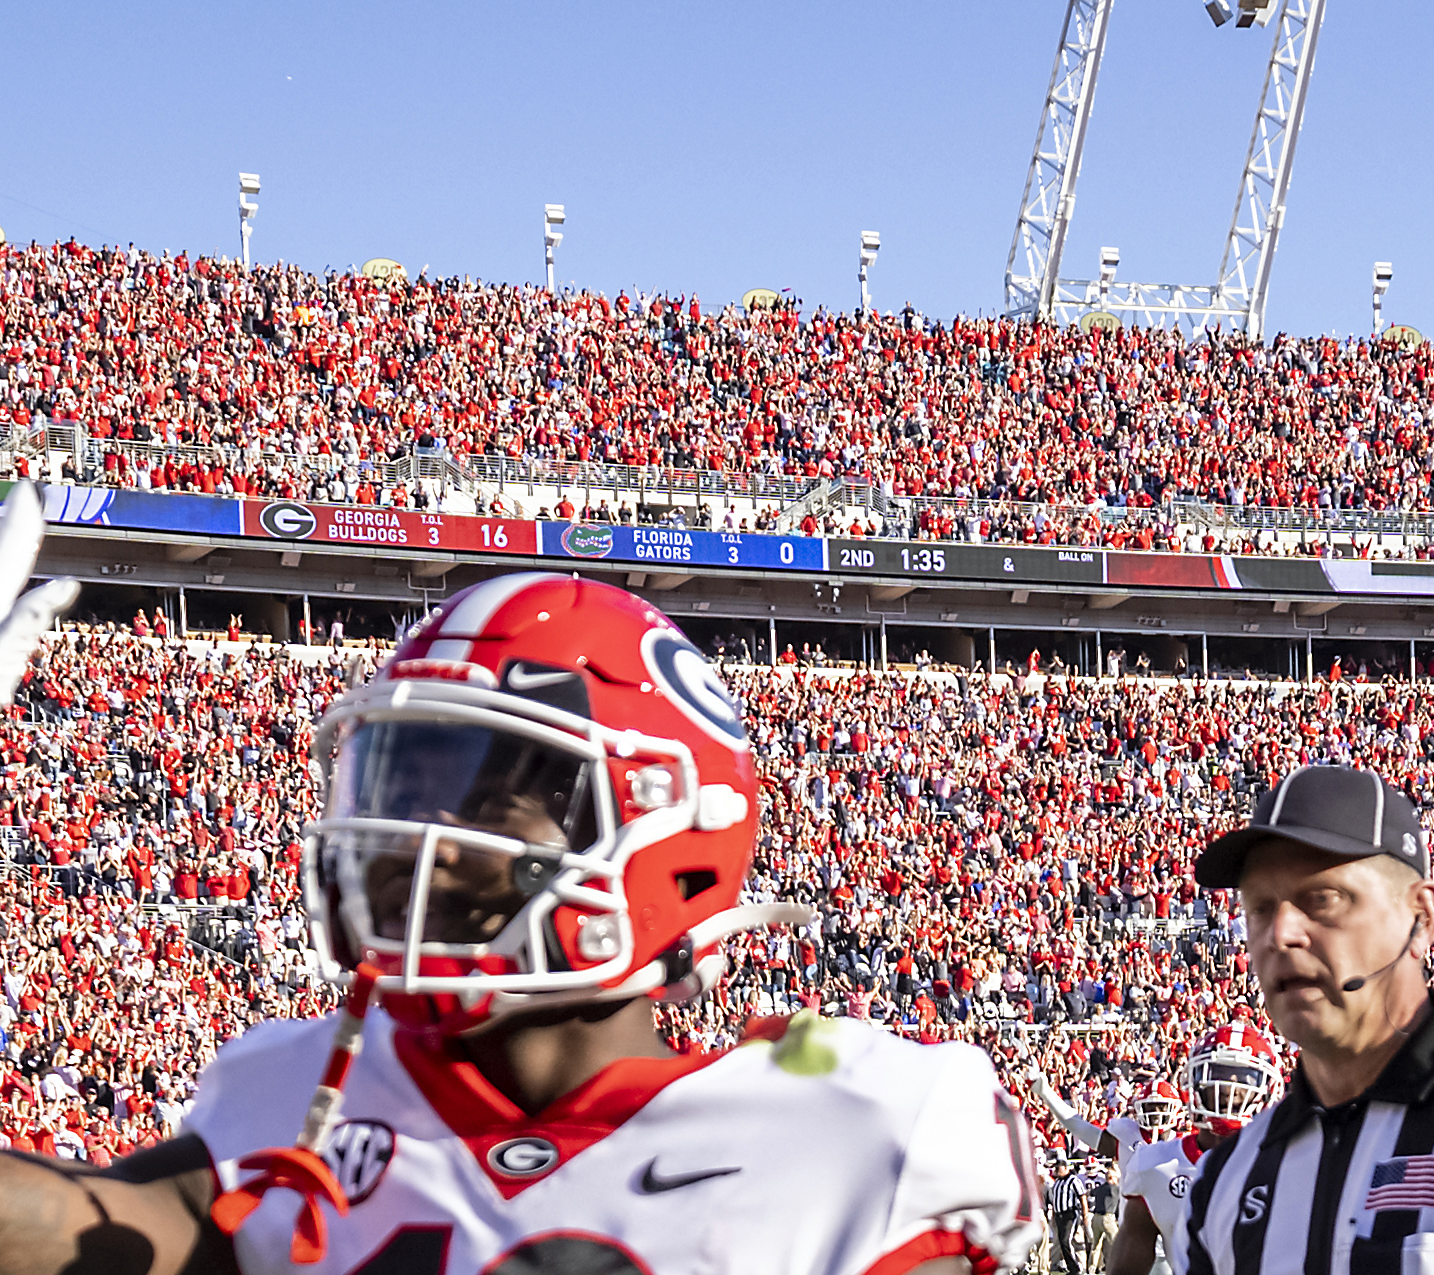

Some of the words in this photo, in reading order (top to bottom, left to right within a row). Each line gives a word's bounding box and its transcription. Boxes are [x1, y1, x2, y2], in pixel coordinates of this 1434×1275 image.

[334, 510, 401, 528] GEORGIA
[328, 525, 408, 543] BULLDOGS
[428, 527, 440, 546] 3
[480, 523, 508, 548] 16
[633, 529, 693, 547] FLORIDA
[635, 543, 691, 561] GATORS
[728, 546, 739, 564] 3
[780, 541, 794, 564] 0
[840, 548, 875, 567] 2ND
[900, 548, 945, 572] 1:35
[1058, 551, 1080, 561] BALL
[1081, 552, 1094, 562] ON
[1003, 557, 1015, 572] &
